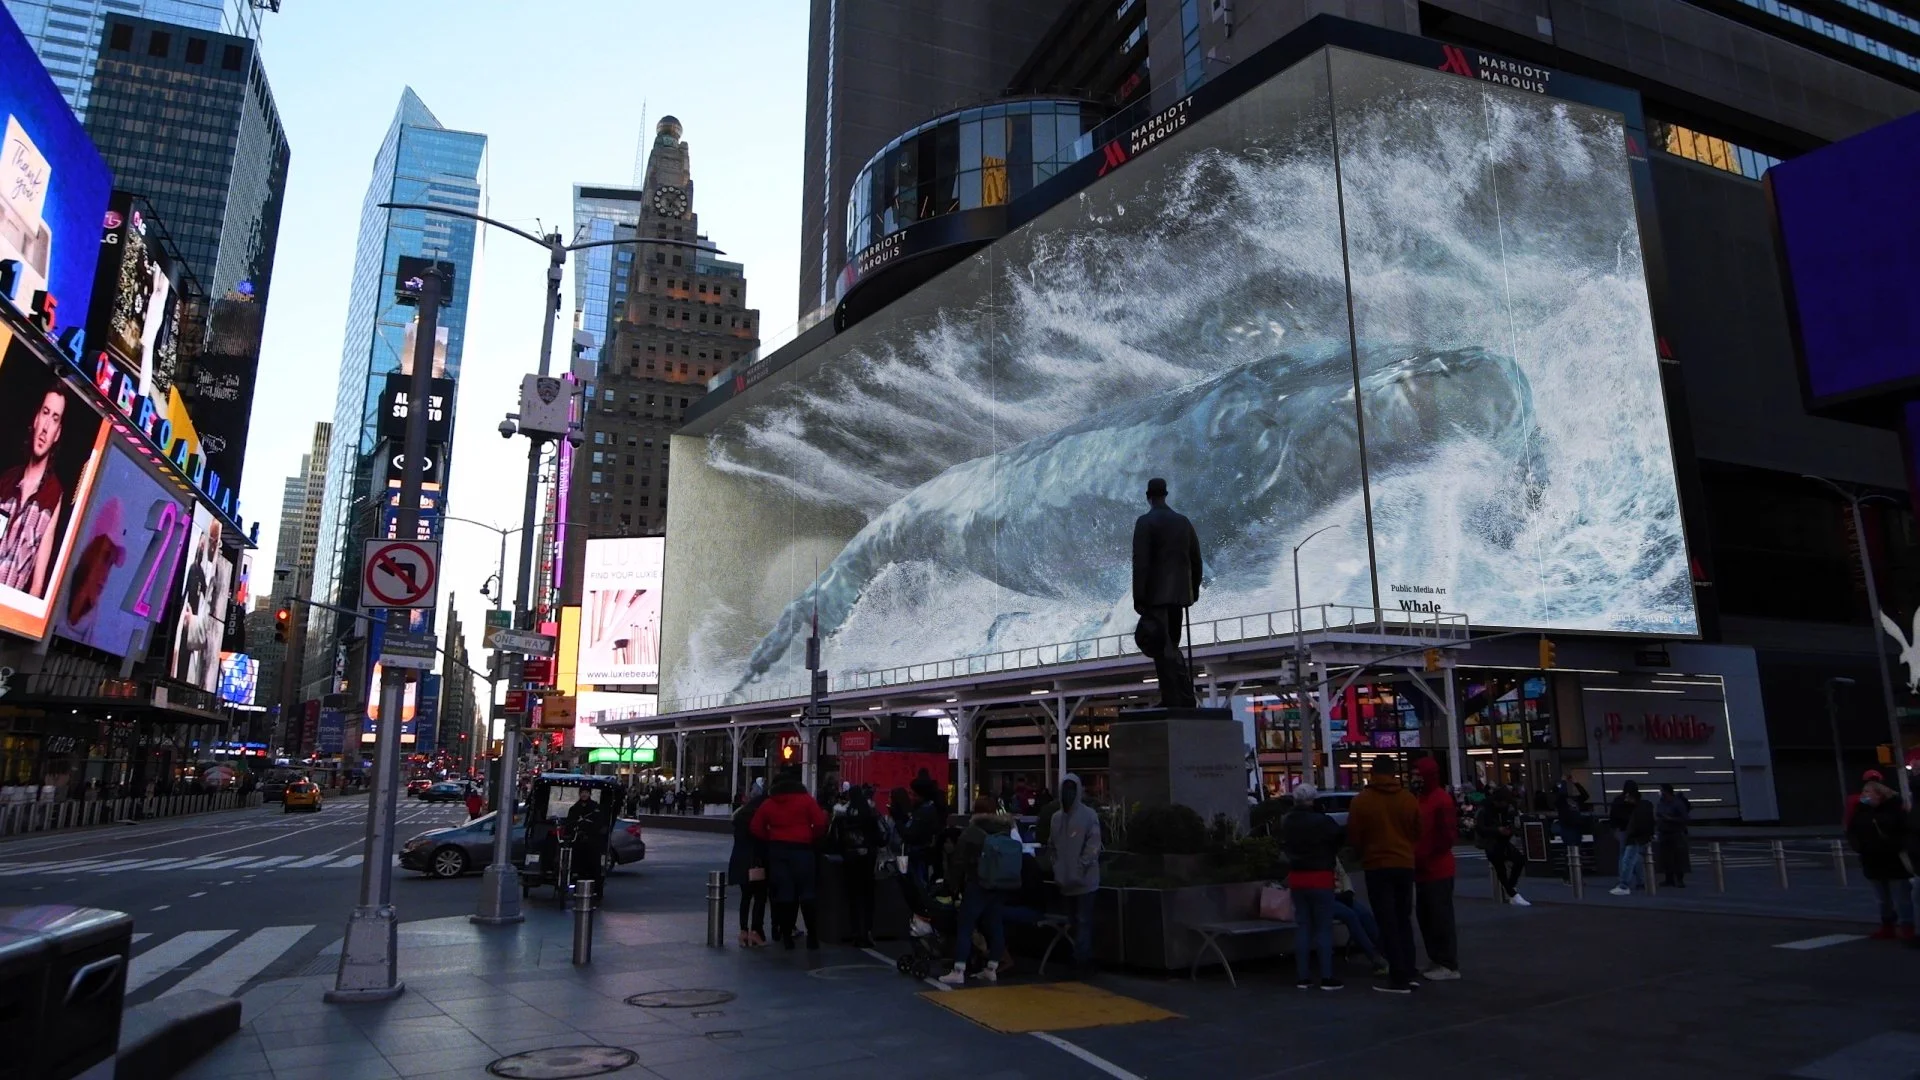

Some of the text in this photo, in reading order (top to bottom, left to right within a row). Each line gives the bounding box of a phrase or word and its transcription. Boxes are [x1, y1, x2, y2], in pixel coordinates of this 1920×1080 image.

[1478, 55, 1551, 82] MARRIOTT
[1480, 69, 1545, 94] MARQUIS
[1131, 95, 1194, 141] MARRIOTT
[1131, 113, 1188, 155] MARQUIS
[857, 230, 908, 263] MARRIOTT
[857, 246, 900, 276] MARQUIS
[117, 373, 242, 524] BROADWAY
[611, 571, 634, 580] YOUR
[1391, 584, 1446, 595] Public Media Art
[1399, 599, 1442, 614] Whale
[384, 638, 429, 649] Times Square
[495, 634, 546, 649] ONE WAY
